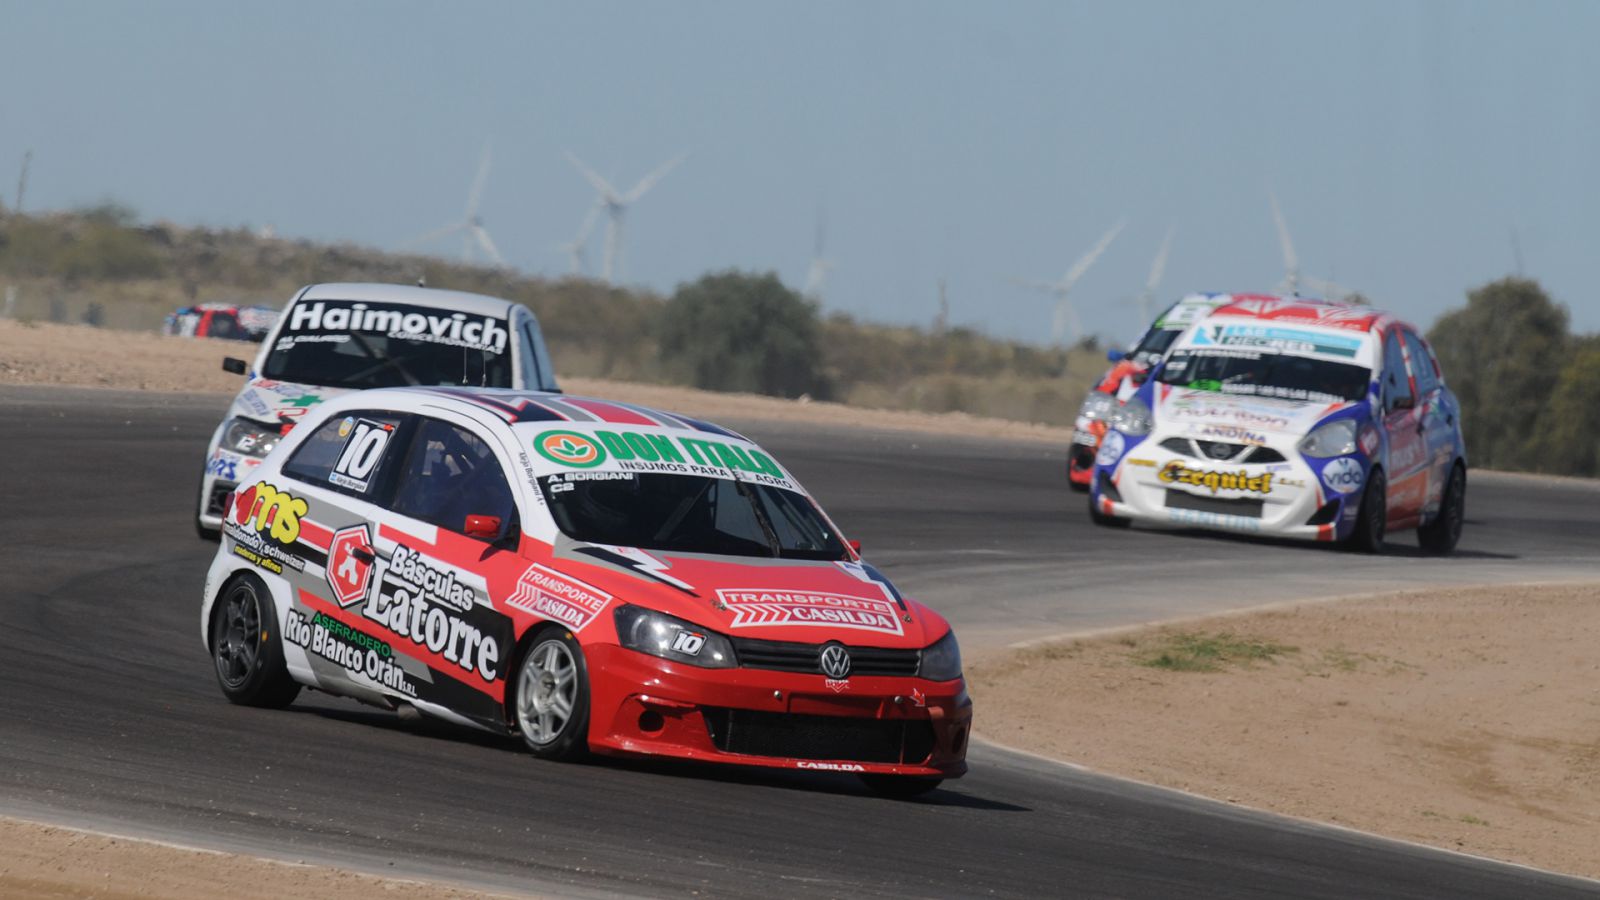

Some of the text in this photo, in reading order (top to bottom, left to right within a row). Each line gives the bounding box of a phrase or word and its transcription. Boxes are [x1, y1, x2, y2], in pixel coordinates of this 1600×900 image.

[290, 302, 508, 348] Haimovich
[335, 423, 389, 479] 10
[1202, 426, 1266, 443] ANDINA
[593, 430, 786, 480] DON ITALO
[548, 471, 634, 484] A. BORGIANI
[619, 460, 687, 473] INSUMOS
[691, 465, 729, 478] PARA
[755, 474, 793, 489] AGRO
[1158, 459, 1275, 493] Ezequiel
[390, 545, 475, 611] Básculas
[525, 570, 603, 610] TRANSPORTE
[363, 556, 499, 681] Latorre
[537, 596, 585, 626] CASILDA
[724, 592, 891, 612] TRANSPORTE
[793, 606, 894, 629] CASILDA
[285, 609, 311, 648] Río
[312, 623, 363, 672] Blanco
[365, 649, 404, 690] Orán
[314, 612, 392, 657] ASERRADERO
[673, 632, 703, 652] 10
[796, 761, 865, 773] CASILDA
